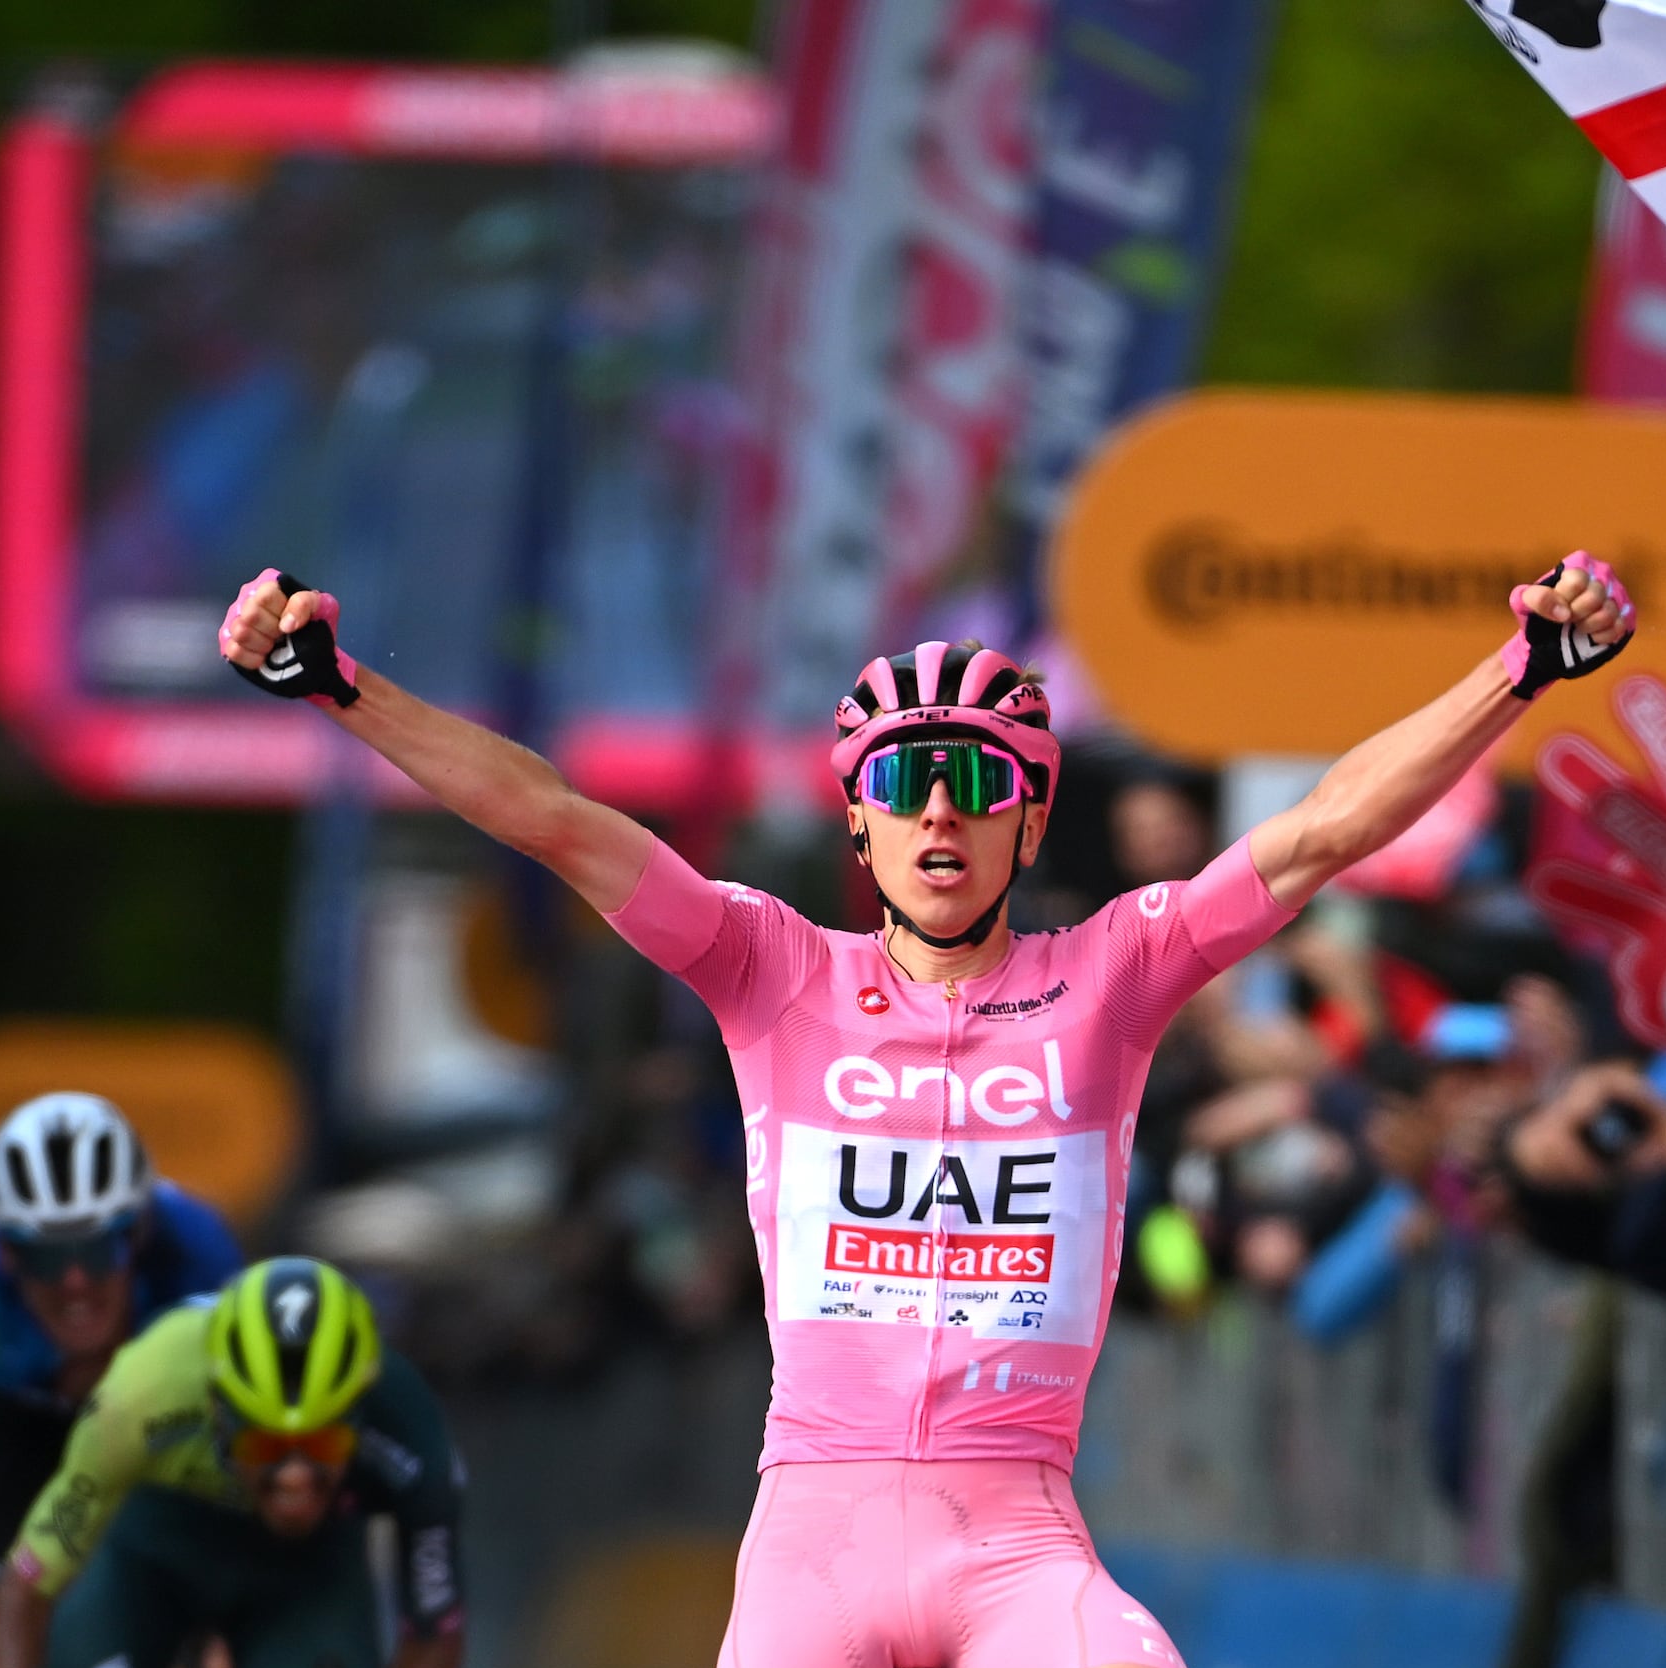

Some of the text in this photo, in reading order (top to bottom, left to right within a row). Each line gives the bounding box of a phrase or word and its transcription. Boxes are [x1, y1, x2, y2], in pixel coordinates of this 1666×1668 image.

[1009, 684, 1043, 708] ME
[836, 698, 857, 717] ET
[901, 708, 956, 722] MET
[1040, 979, 1070, 1005] Sport
[823, 1039, 1074, 1127] enel
[838, 1143, 1058, 1225] UAE
[832, 1229, 1047, 1277] Emirates
[823, 1279, 852, 1292] FAB
[944, 1289, 999, 1304] presight
[1016, 1371, 1076, 1387] ITALIA.IT
